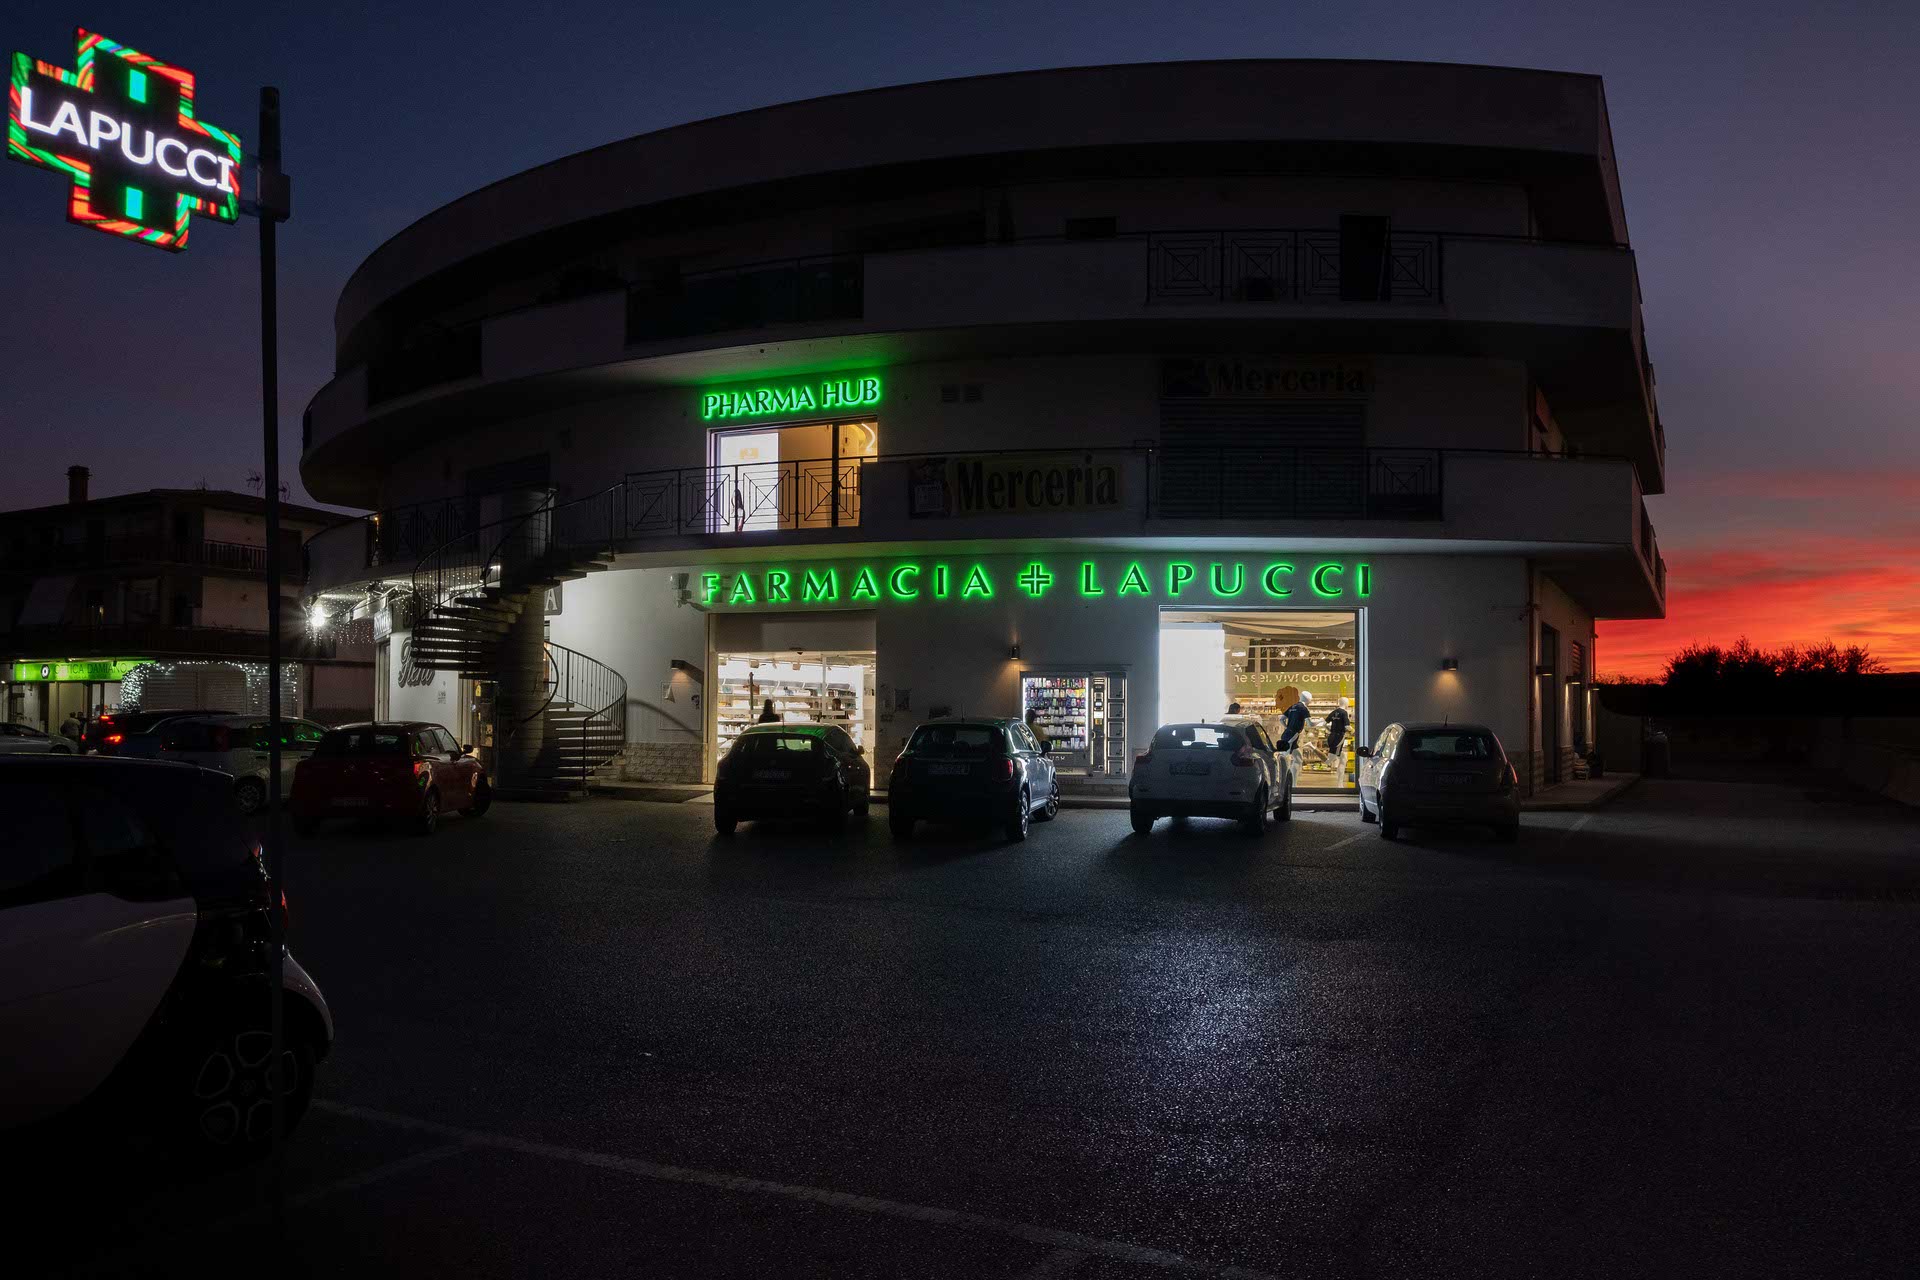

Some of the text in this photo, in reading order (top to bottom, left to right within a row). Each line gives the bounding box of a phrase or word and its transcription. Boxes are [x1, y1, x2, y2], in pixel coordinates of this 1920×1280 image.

[20, 86, 235, 193] LAPUCCI
[1216, 357, 1366, 393] Merceria
[703, 377, 880, 418] PHARMA HUB
[958, 454, 1118, 511] Merceria
[701, 562, 1372, 604] FARMACIA LAPUCCI
[87, 662, 128, 674] DAMIANO
[1301, 674, 1341, 683] come
